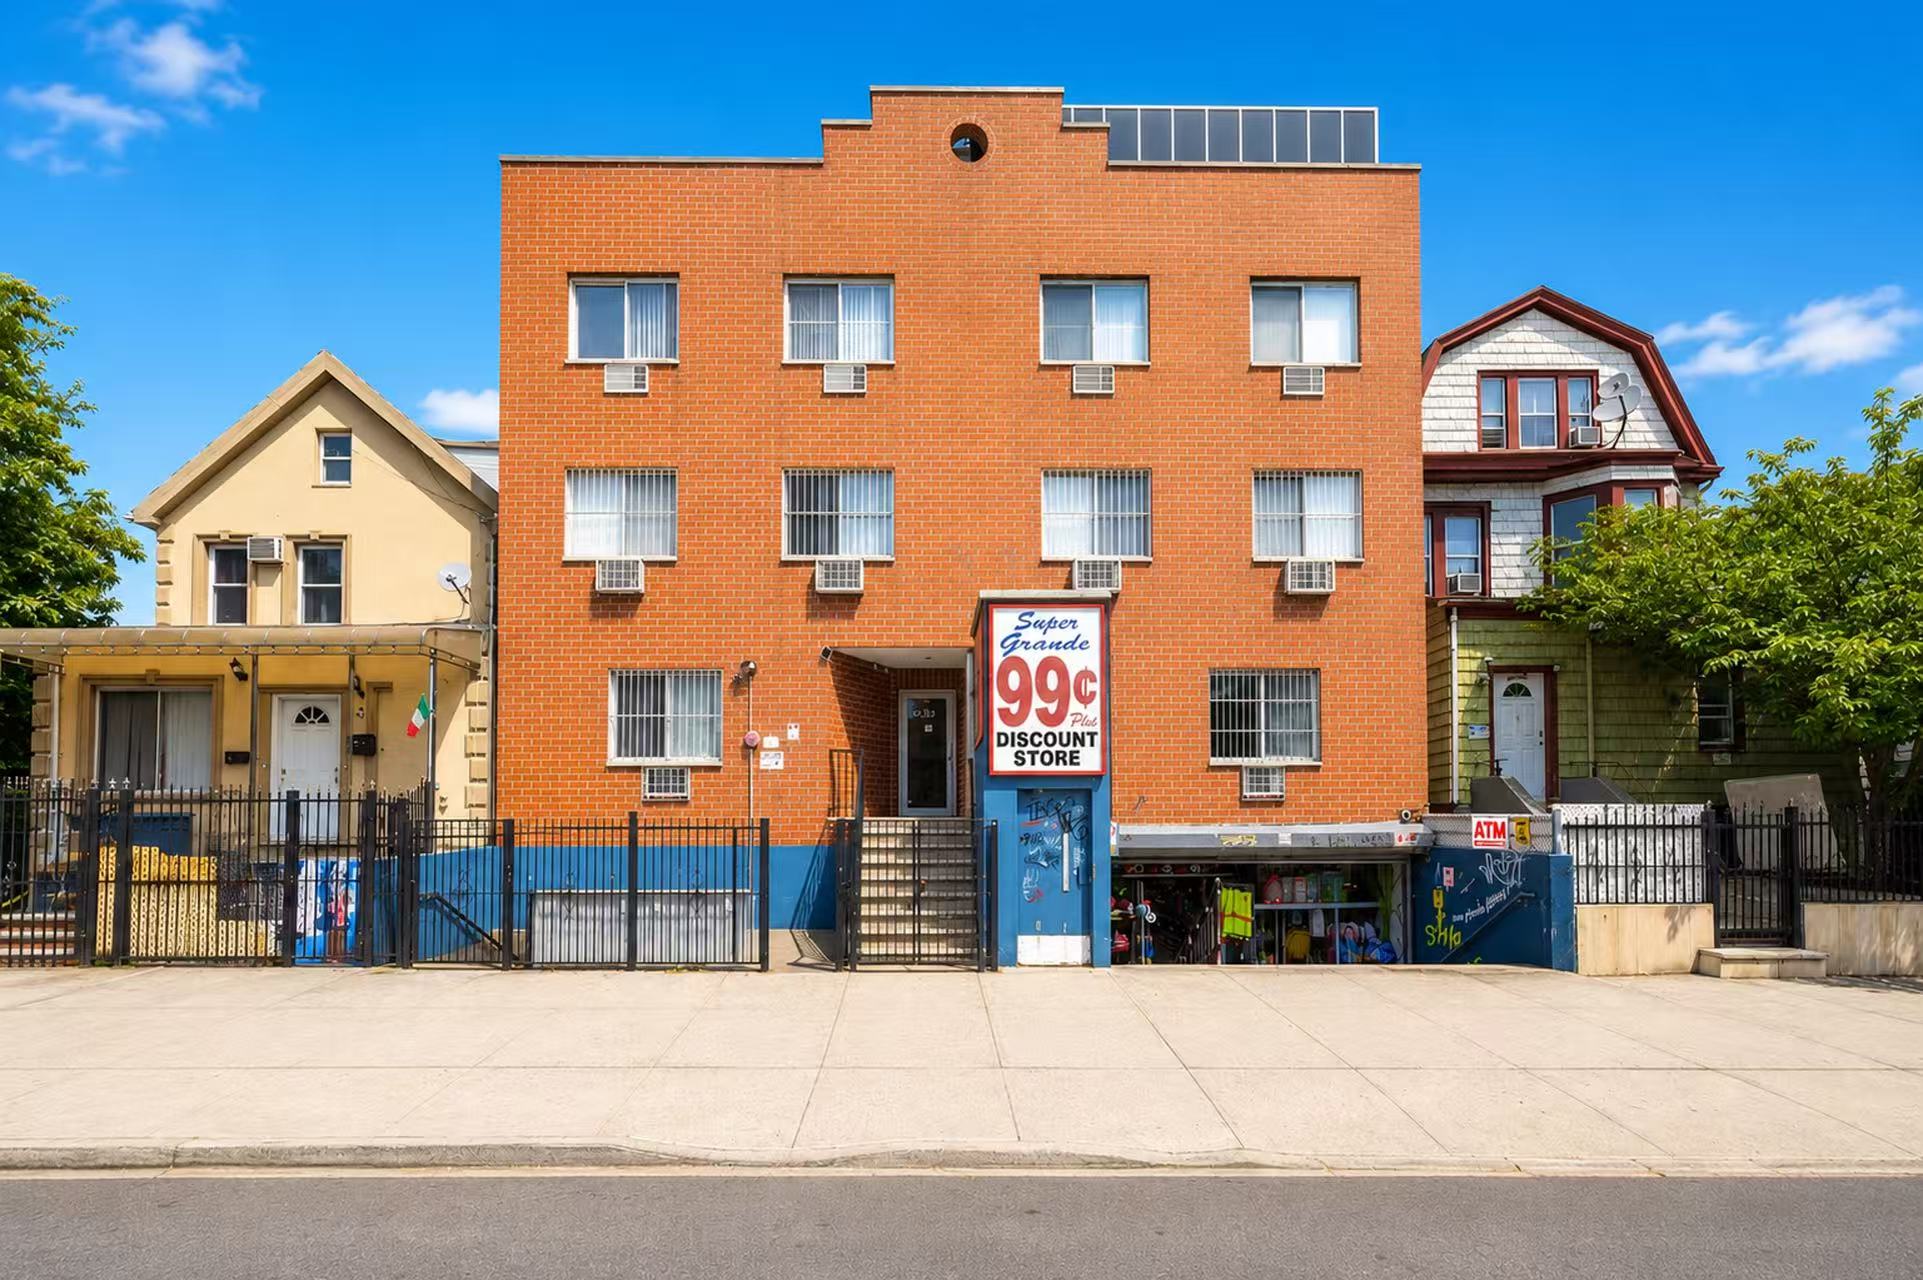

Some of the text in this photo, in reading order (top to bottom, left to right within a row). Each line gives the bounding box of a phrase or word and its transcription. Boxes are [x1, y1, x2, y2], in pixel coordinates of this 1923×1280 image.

[1014, 611, 1078, 635] Super
[1000, 633, 1090, 657] Grande
[996, 655, 1097, 727] 99¢
[996, 731, 1098, 747] DISCOUNT
[1014, 750, 1080, 766] STORE
[1474, 820, 1506, 839] ATM
